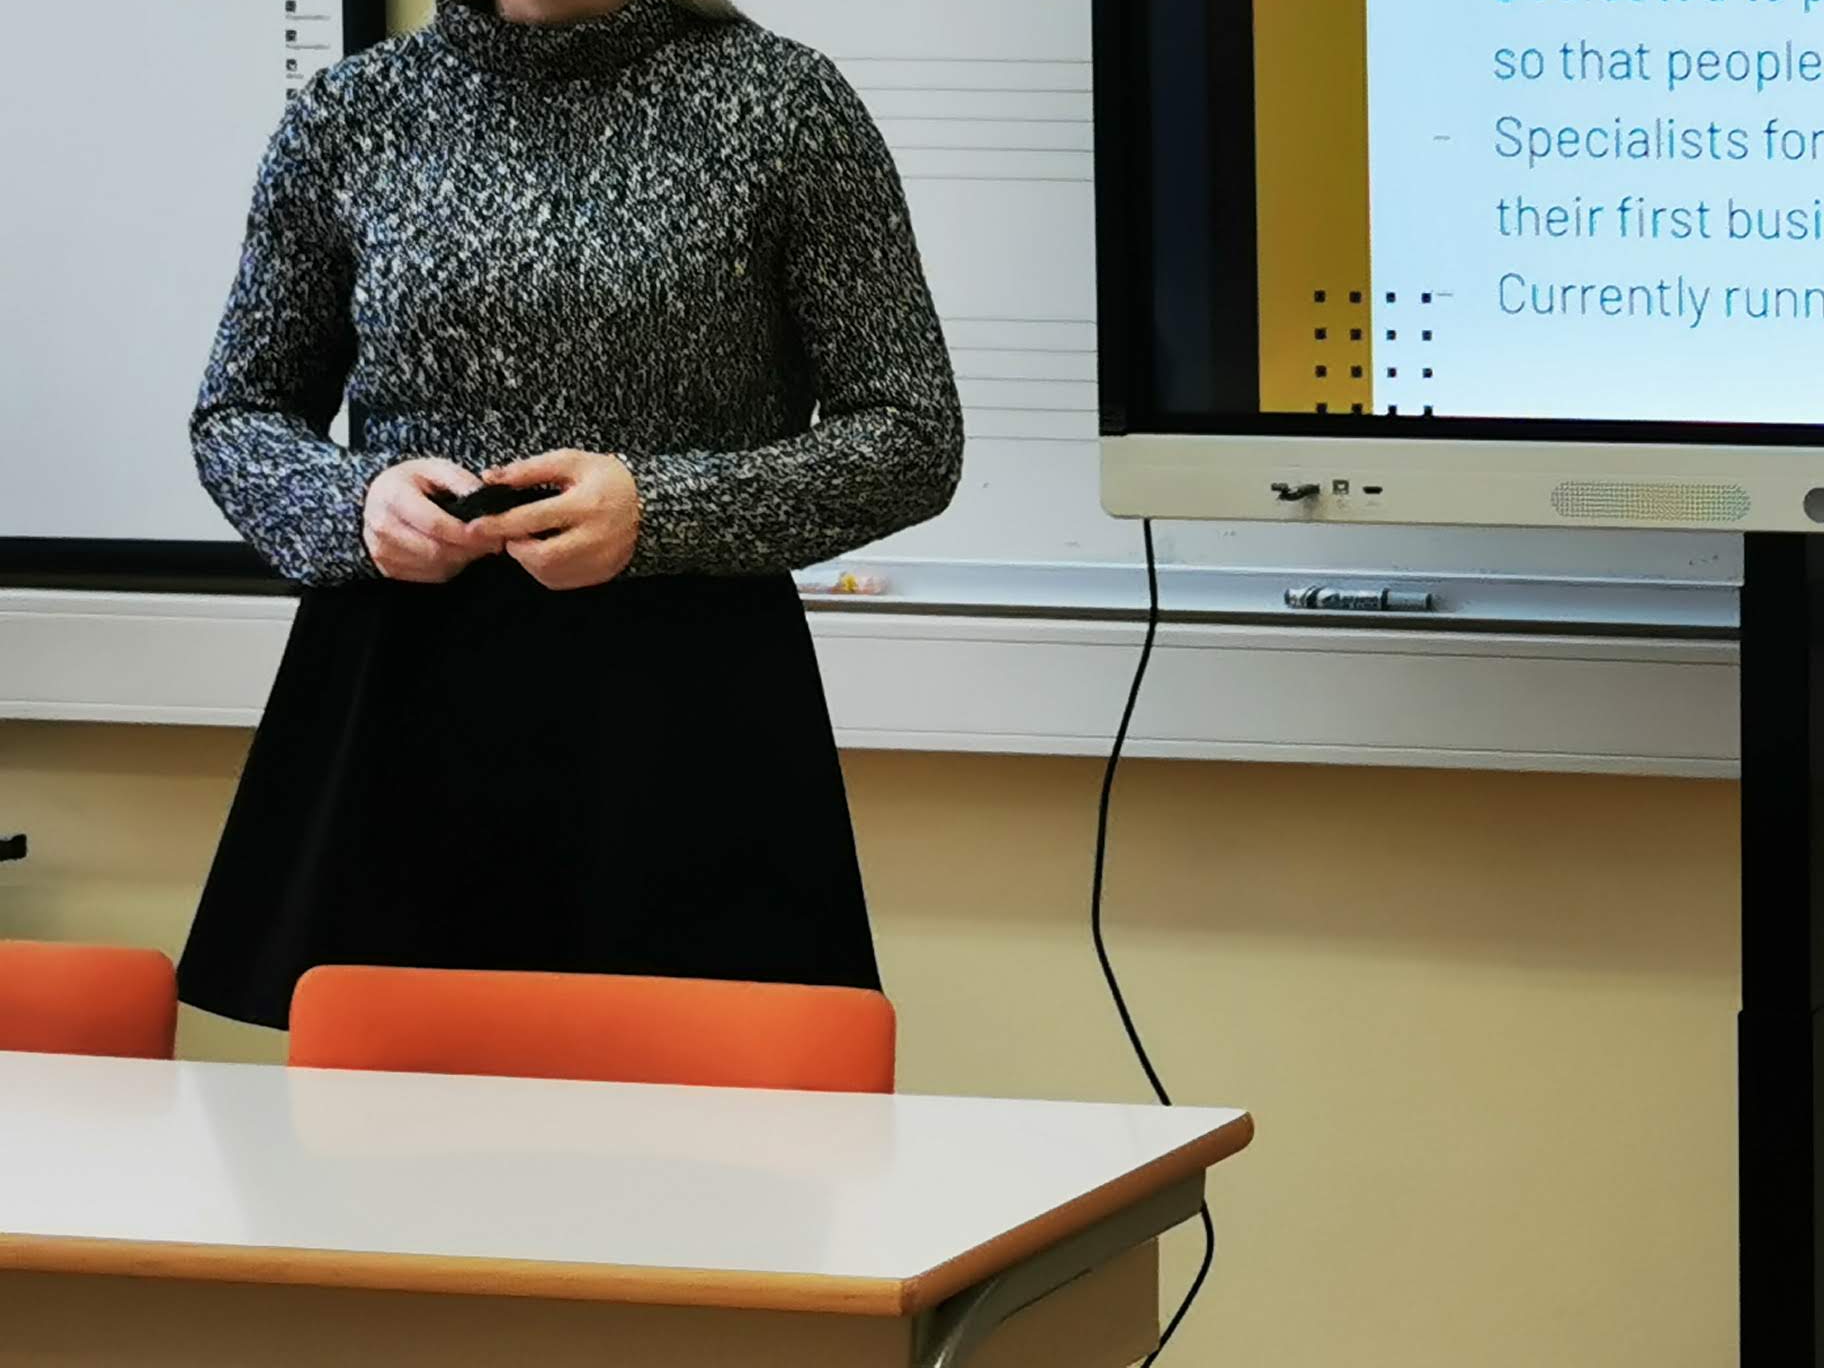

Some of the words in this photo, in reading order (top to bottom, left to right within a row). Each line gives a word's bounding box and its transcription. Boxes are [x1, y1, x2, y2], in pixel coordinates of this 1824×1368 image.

[1494, 45, 1544, 81] so
[1560, 40, 1651, 82] that
[1668, 41, 1823, 93] people
[1495, 115, 1749, 169] Specialists
[1497, 196, 1604, 238] their
[1618, 195, 1711, 240] first
[1498, 272, 1710, 329] Currently
